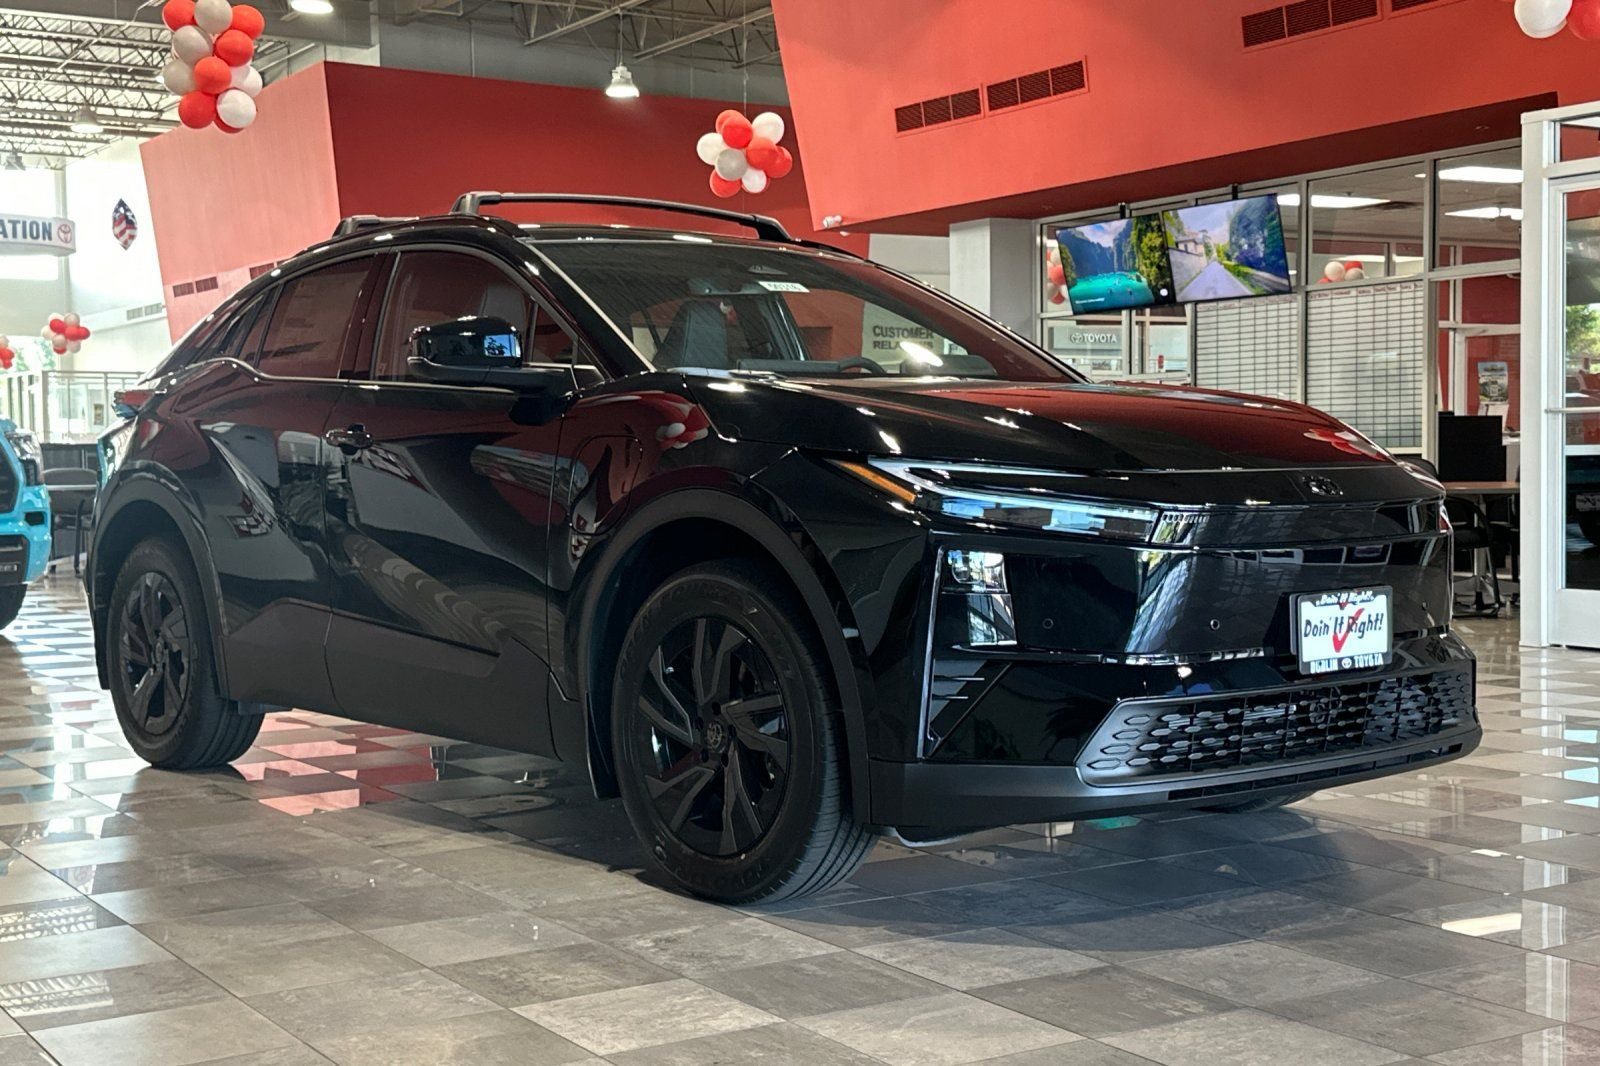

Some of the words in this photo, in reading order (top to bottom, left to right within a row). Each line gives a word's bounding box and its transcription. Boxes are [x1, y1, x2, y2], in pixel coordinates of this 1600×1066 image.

[872, 325, 934, 340] CUSTOMER
[1083, 332, 1117, 344] TOYOTA
[1333, 616, 1344, 634] It
[1346, 612, 1384, 640] Right!
[1353, 652, 1384, 668] TOYOTA
